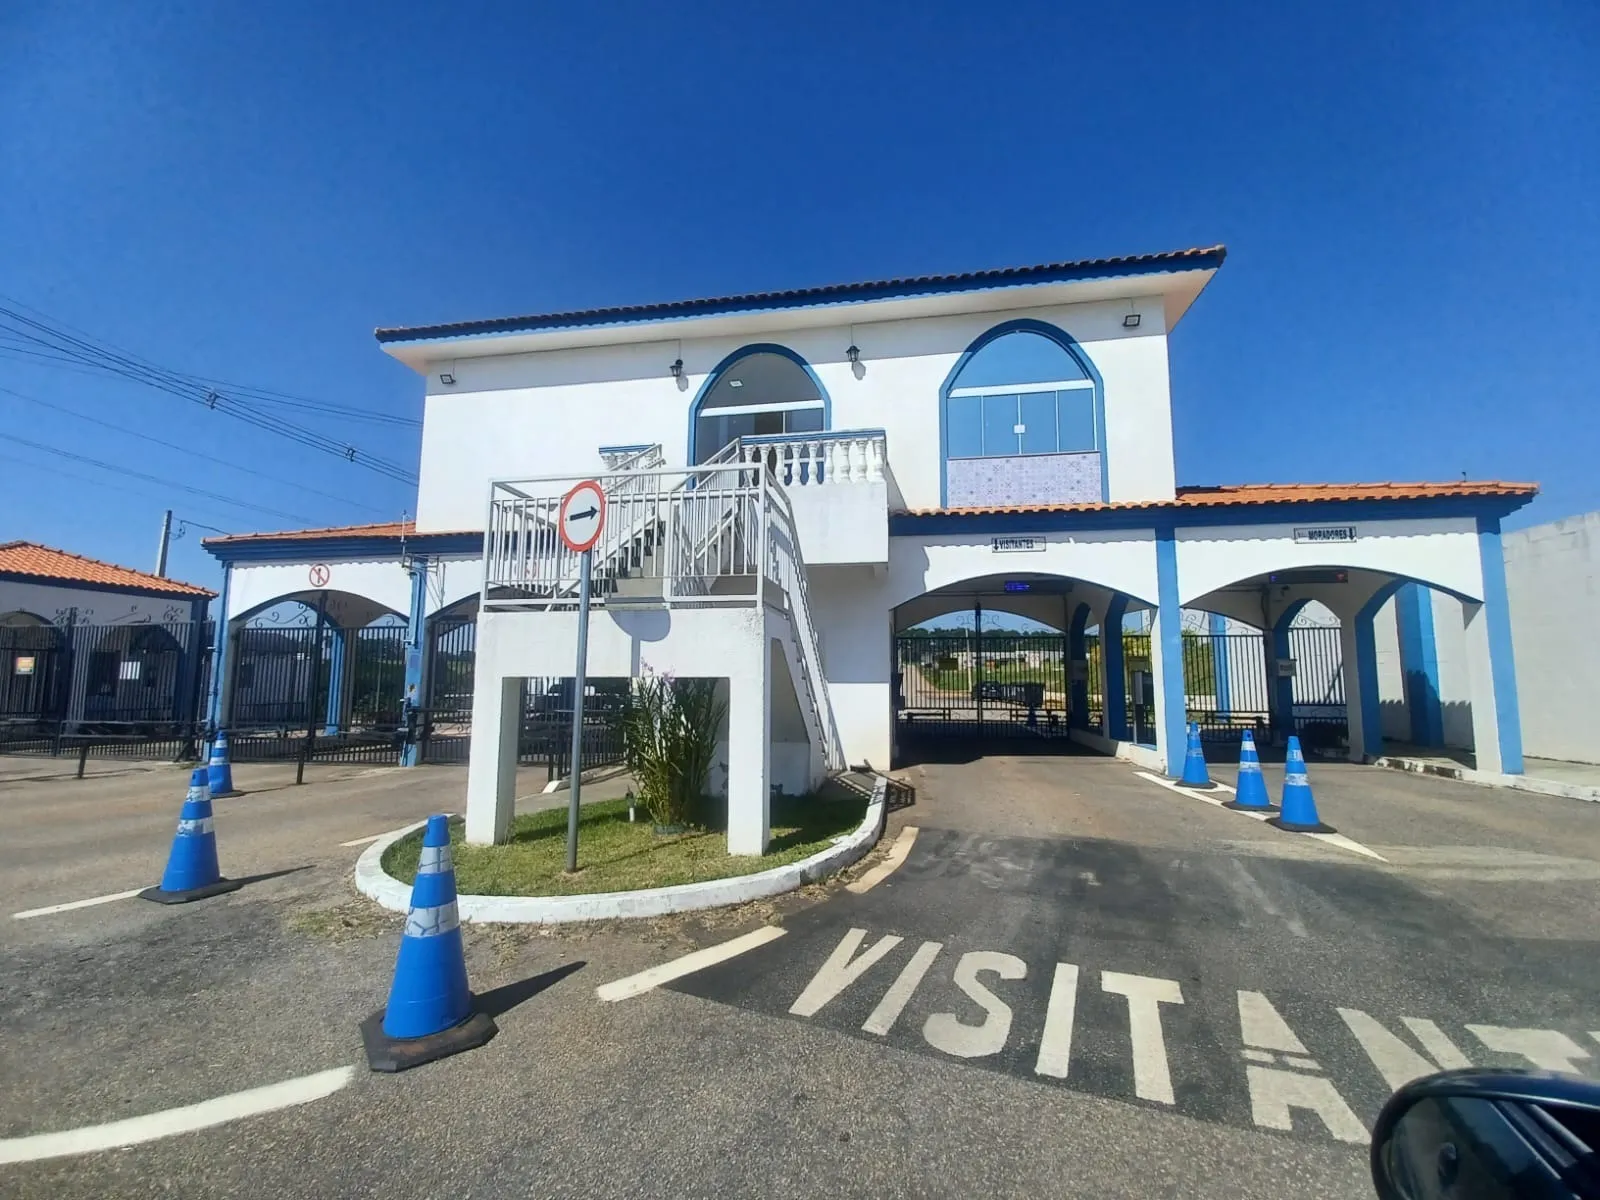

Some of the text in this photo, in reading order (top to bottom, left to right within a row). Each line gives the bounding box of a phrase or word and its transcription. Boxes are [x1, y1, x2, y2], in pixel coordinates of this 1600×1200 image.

[1308, 529, 1347, 540] MORADORES
[999, 539, 1034, 550] VISITANTES
[789, 927, 1600, 1144] VISITANT
